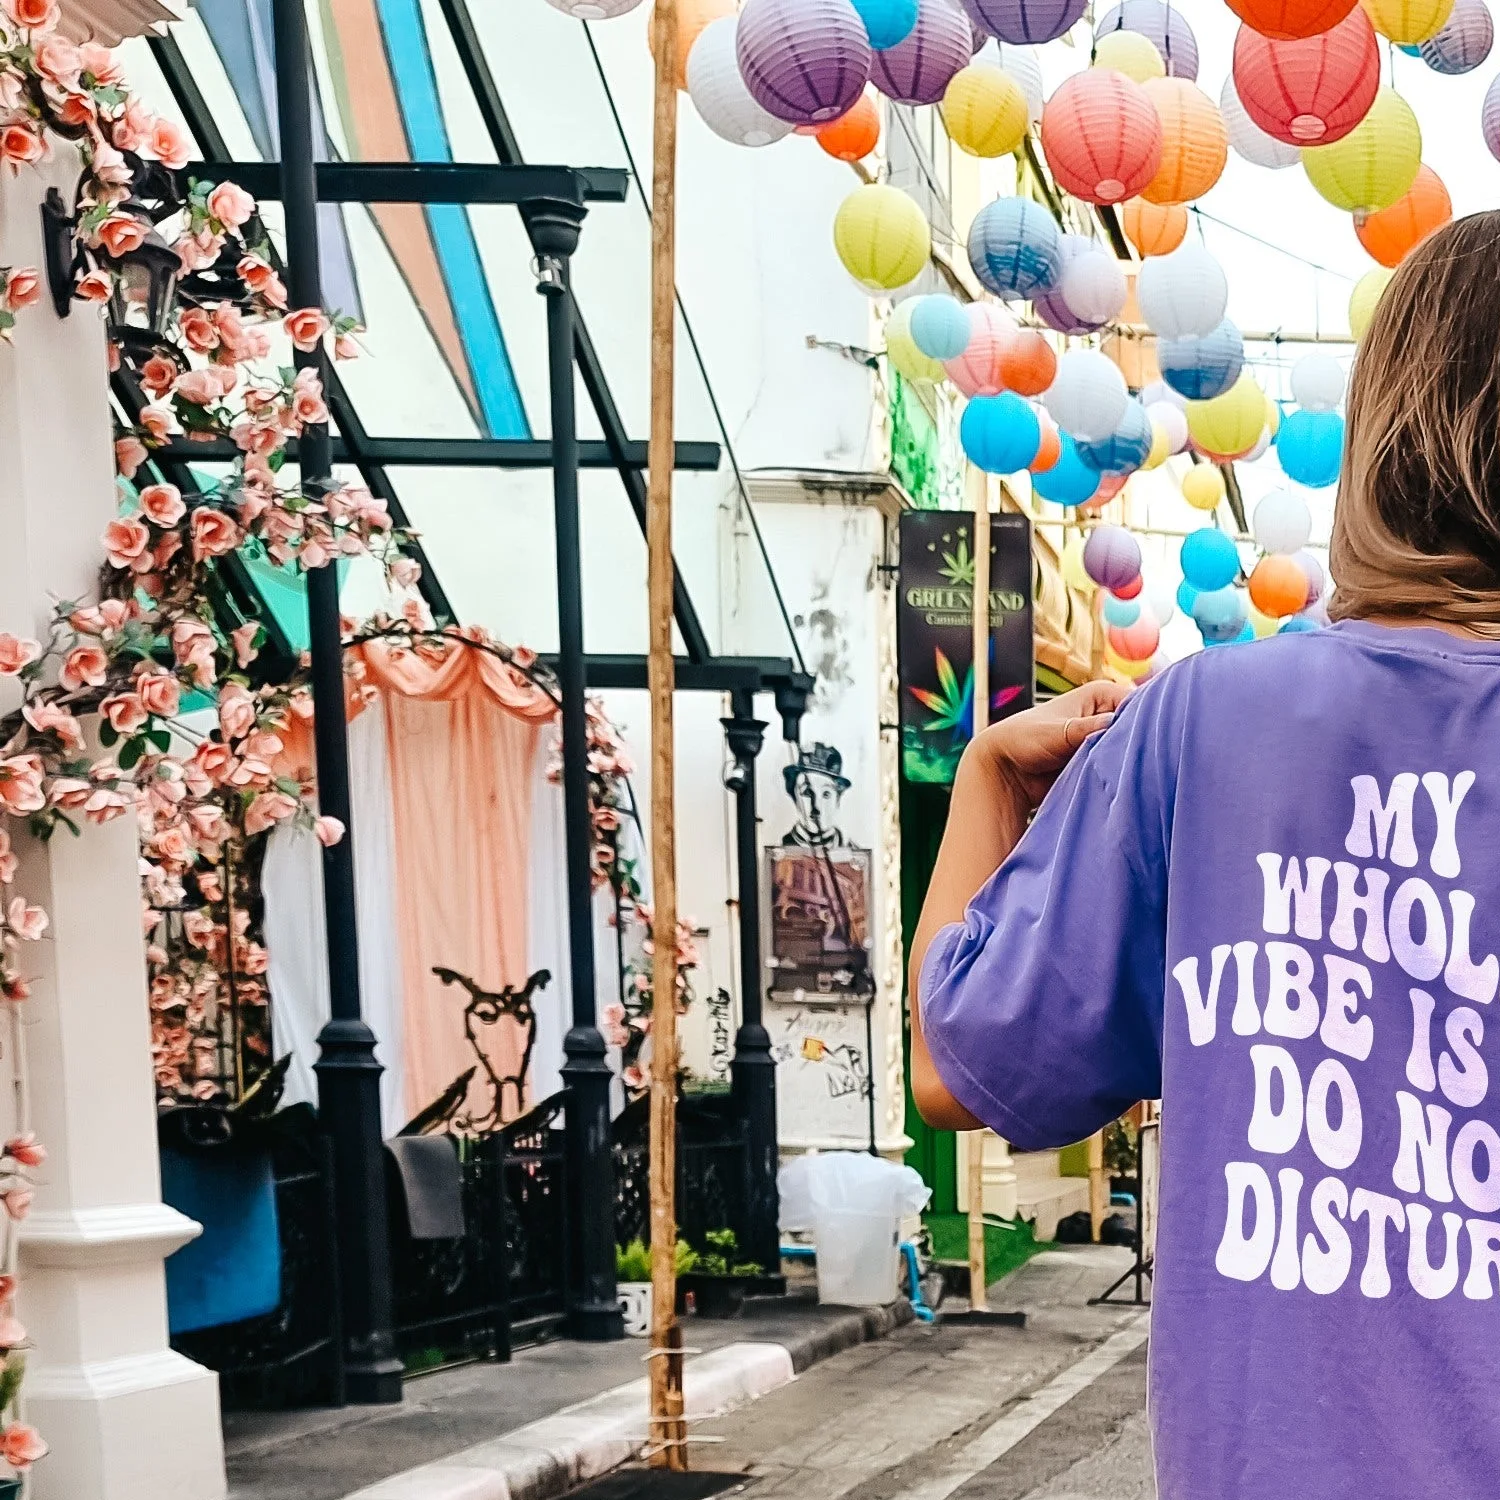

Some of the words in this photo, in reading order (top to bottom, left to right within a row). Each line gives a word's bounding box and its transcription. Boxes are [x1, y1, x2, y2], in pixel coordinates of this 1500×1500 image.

[906, 588, 1025, 611] GREENAND
[1344, 770, 1477, 879] MY
[1171, 940, 1375, 1062] VIBE
[1404, 987, 1489, 1108] IS
[1247, 1043, 1363, 1170] DO
